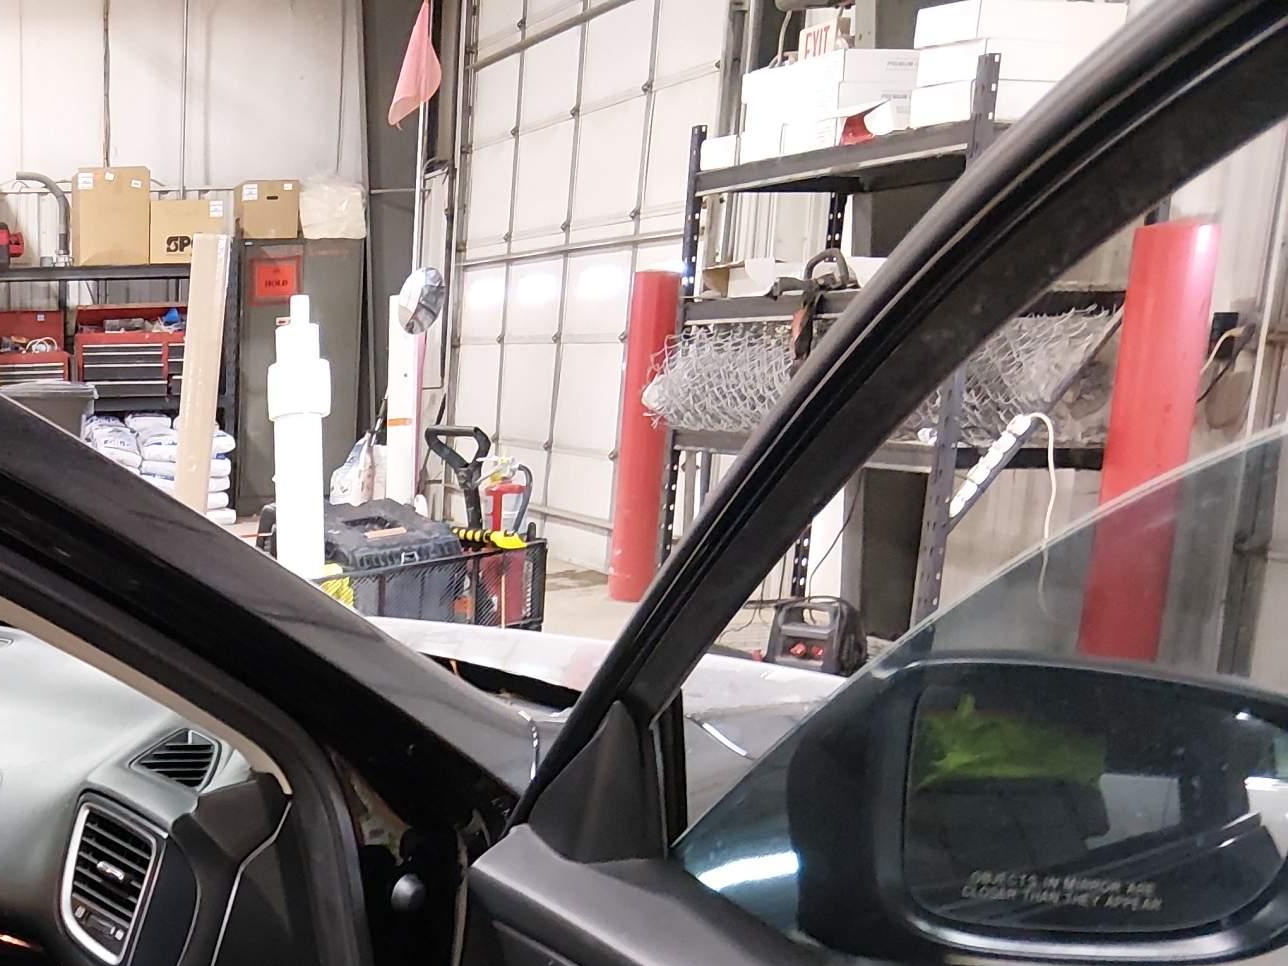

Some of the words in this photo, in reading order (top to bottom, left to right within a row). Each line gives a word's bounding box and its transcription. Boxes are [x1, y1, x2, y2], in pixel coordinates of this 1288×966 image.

[804, 25, 831, 60] EXIT
[166, 235, 193, 252] SP
[969, 870, 1038, 889] OBJECTS
